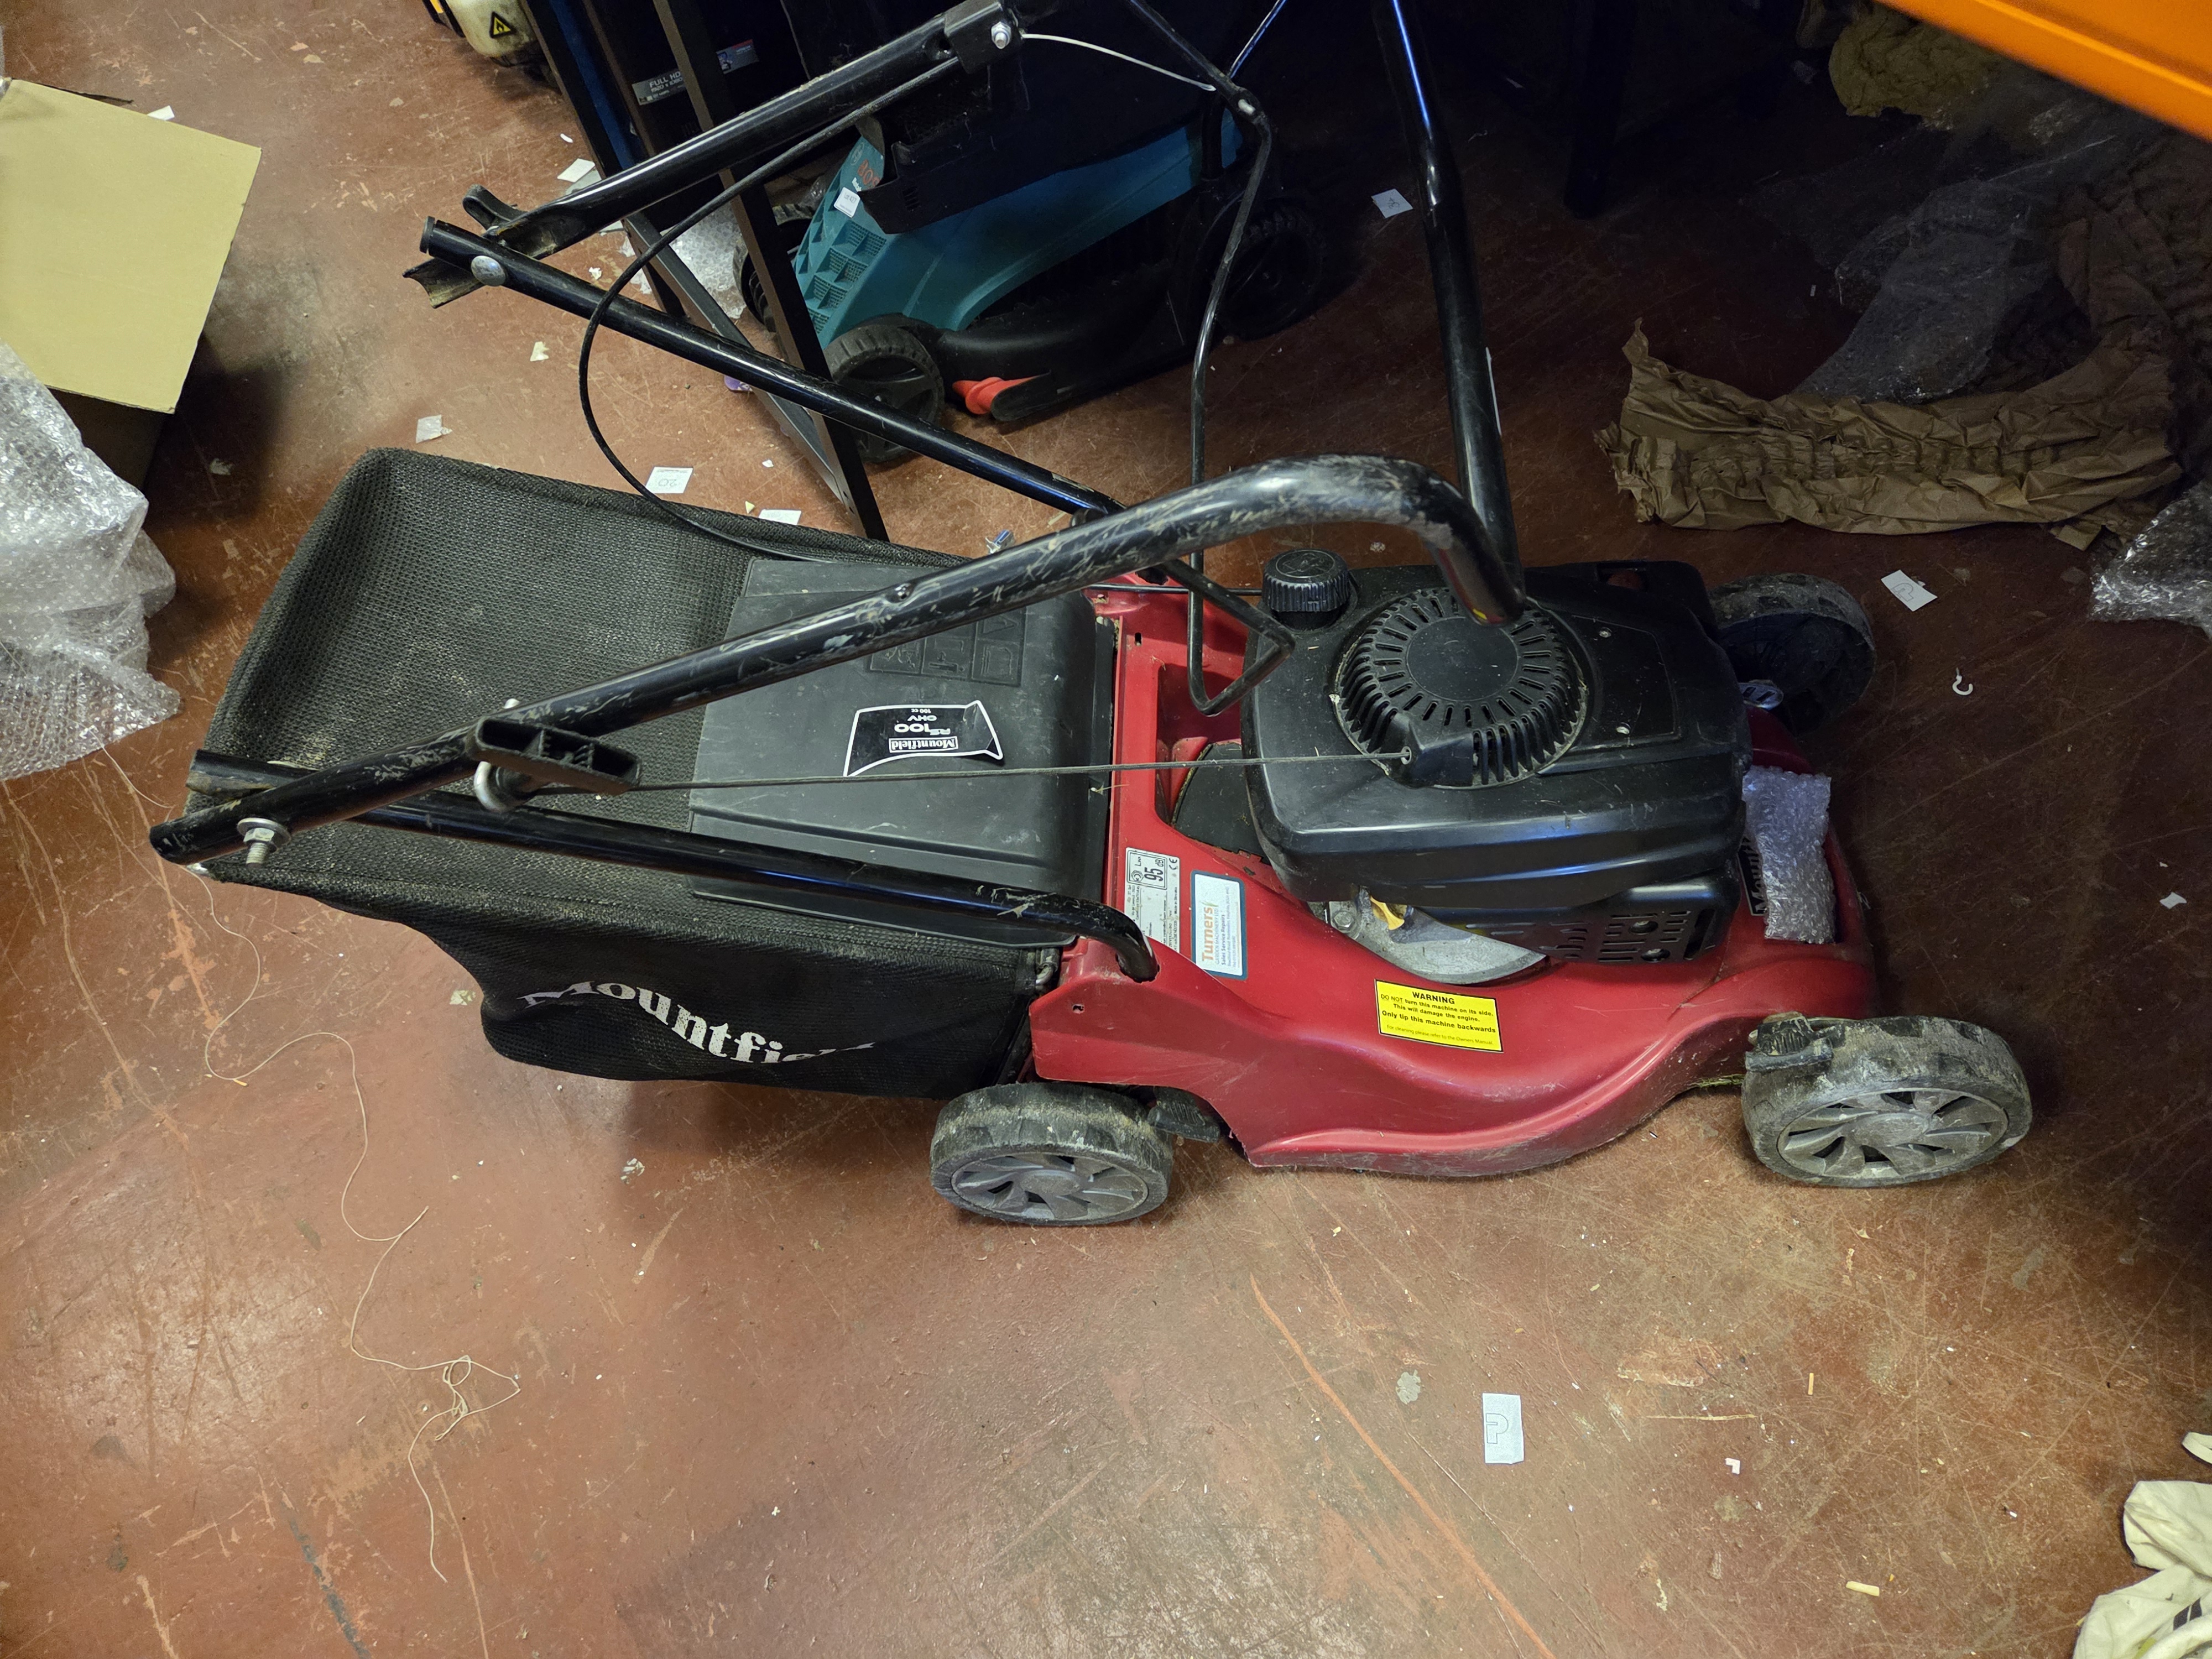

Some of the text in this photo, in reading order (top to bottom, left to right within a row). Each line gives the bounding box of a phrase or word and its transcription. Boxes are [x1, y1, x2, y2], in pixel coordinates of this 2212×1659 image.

[649, 77, 669, 87] FULL
[891, 738, 955, 750] Mountfield
[1144, 859, 1164, 881] 95 dB
[1201, 907, 1213, 961] Turners
[1412, 991, 1455, 1004] WARNING
[1420, 1008, 1443, 1017] damage
[1432, 1004, 1458, 1012] machine
[1381, 1010, 1397, 1019] Only
[1426, 1019, 1455, 1028] machine
[1457, 1023, 1496, 1033] backwards
[1395, 1026, 1415, 1035] cleaning
